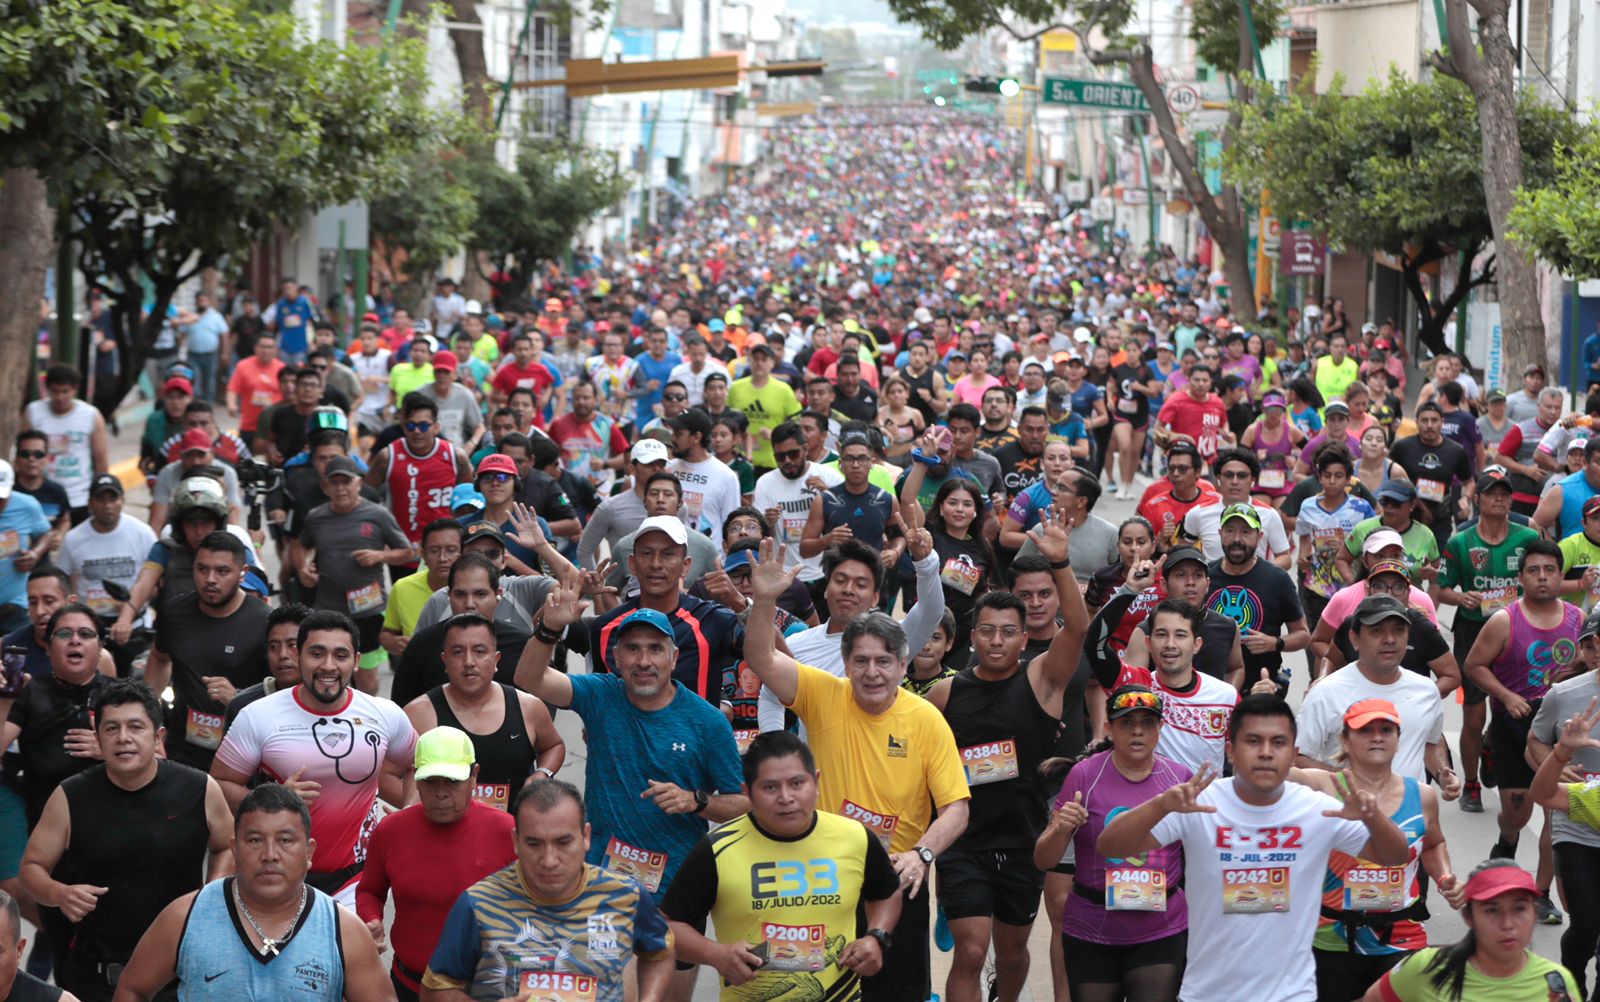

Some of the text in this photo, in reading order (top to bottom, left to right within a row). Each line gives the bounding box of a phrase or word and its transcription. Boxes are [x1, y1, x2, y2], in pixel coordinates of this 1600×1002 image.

[1173, 91, 1193, 105] 40
[1488, 324, 1502, 391] nfinitum
[673, 470, 708, 485] OSERS
[428, 486, 454, 508] 32
[192, 712, 222, 728] 1220
[733, 730, 749, 740] 32
[964, 743, 1001, 761] 9384
[472, 785, 494, 798] 19
[845, 803, 882, 826] 9799
[614, 841, 649, 863] 1853
[751, 858, 839, 899] E33
[1112, 870, 1149, 883] 2440
[1225, 869, 1268, 884] 9242
[1348, 869, 1388, 883] 3535
[751, 895, 841, 910] 18/JULIO/2022
[765, 924, 809, 941] 9200
[588, 940, 618, 949] META
[526, 973, 574, 991] 8215
